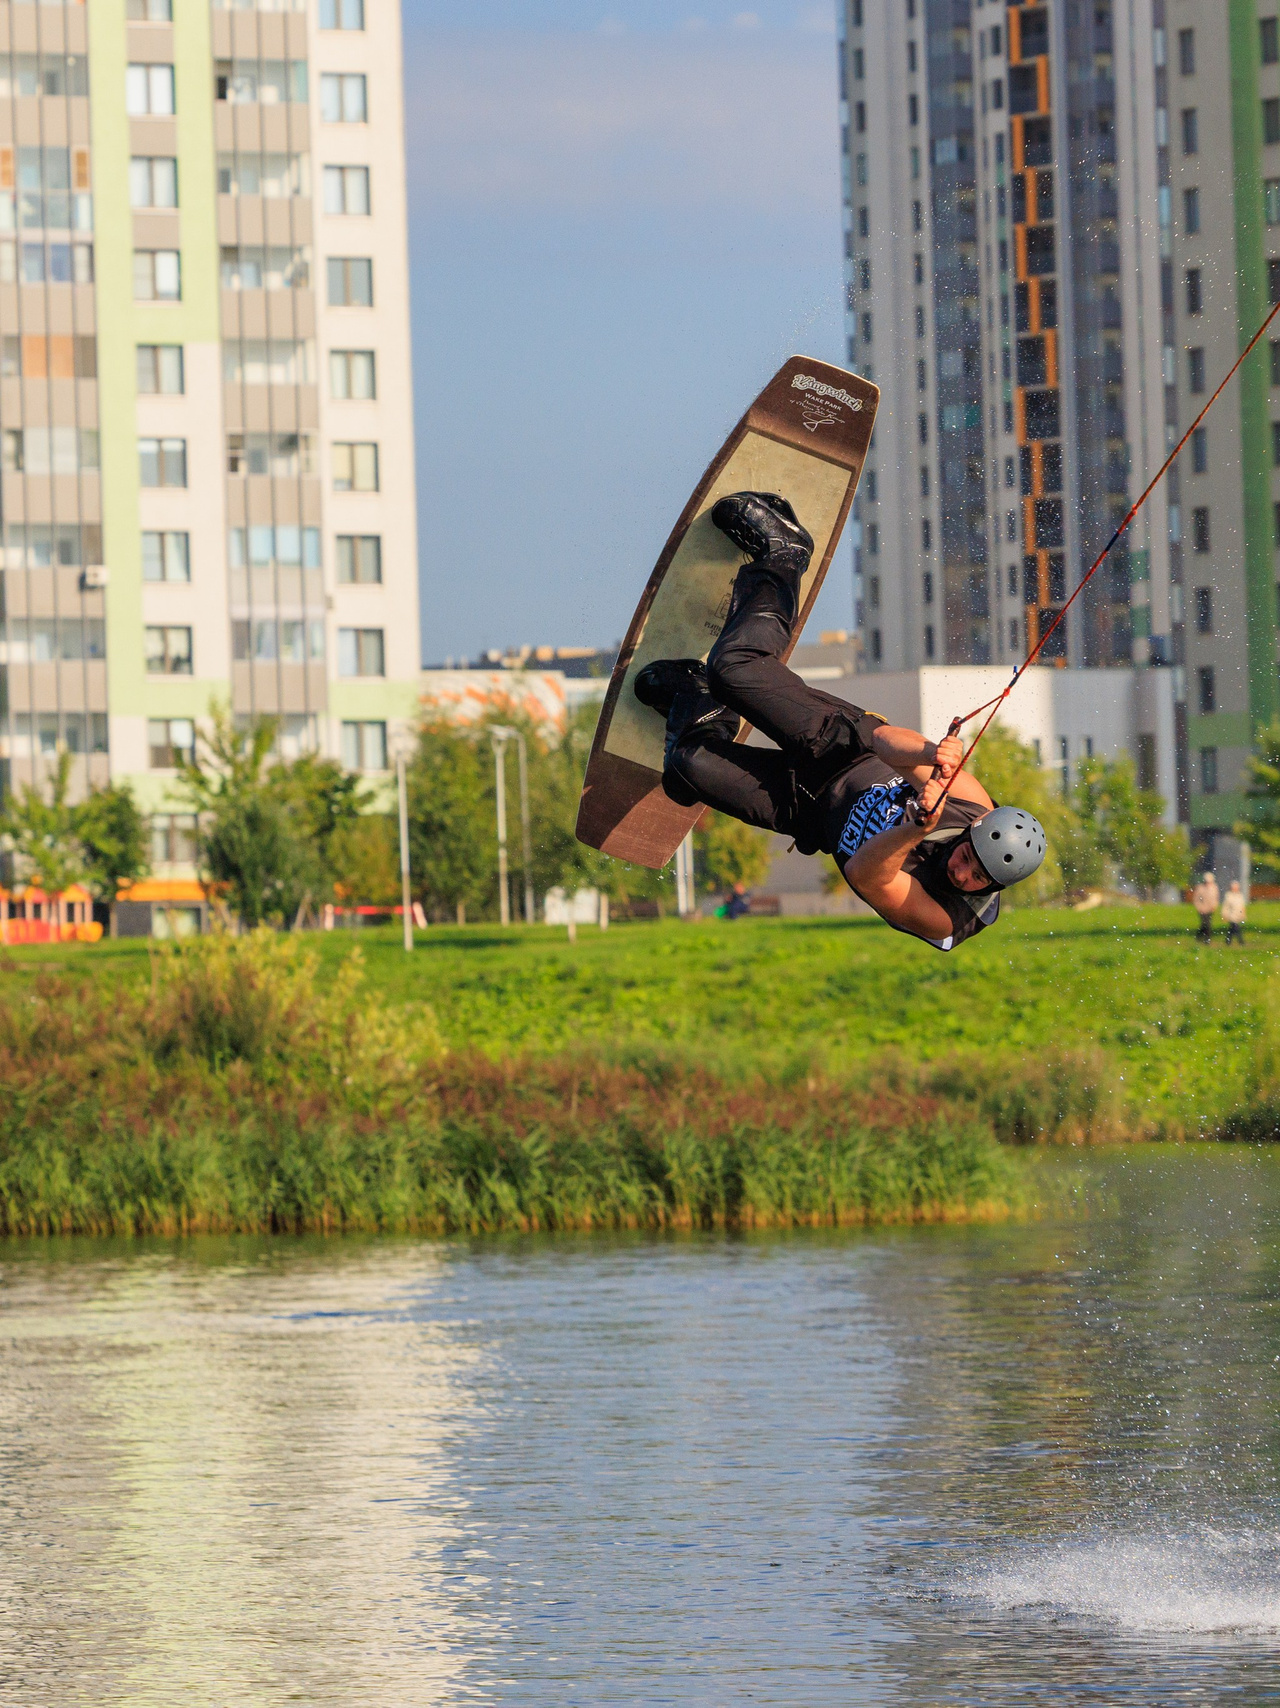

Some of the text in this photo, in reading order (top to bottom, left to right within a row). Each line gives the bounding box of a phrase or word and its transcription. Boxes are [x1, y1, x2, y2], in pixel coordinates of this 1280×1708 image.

[805, 393, 824, 404] WAKE
[825, 400, 842, 411] PARK
[838, 786, 888, 856] CONTEST
